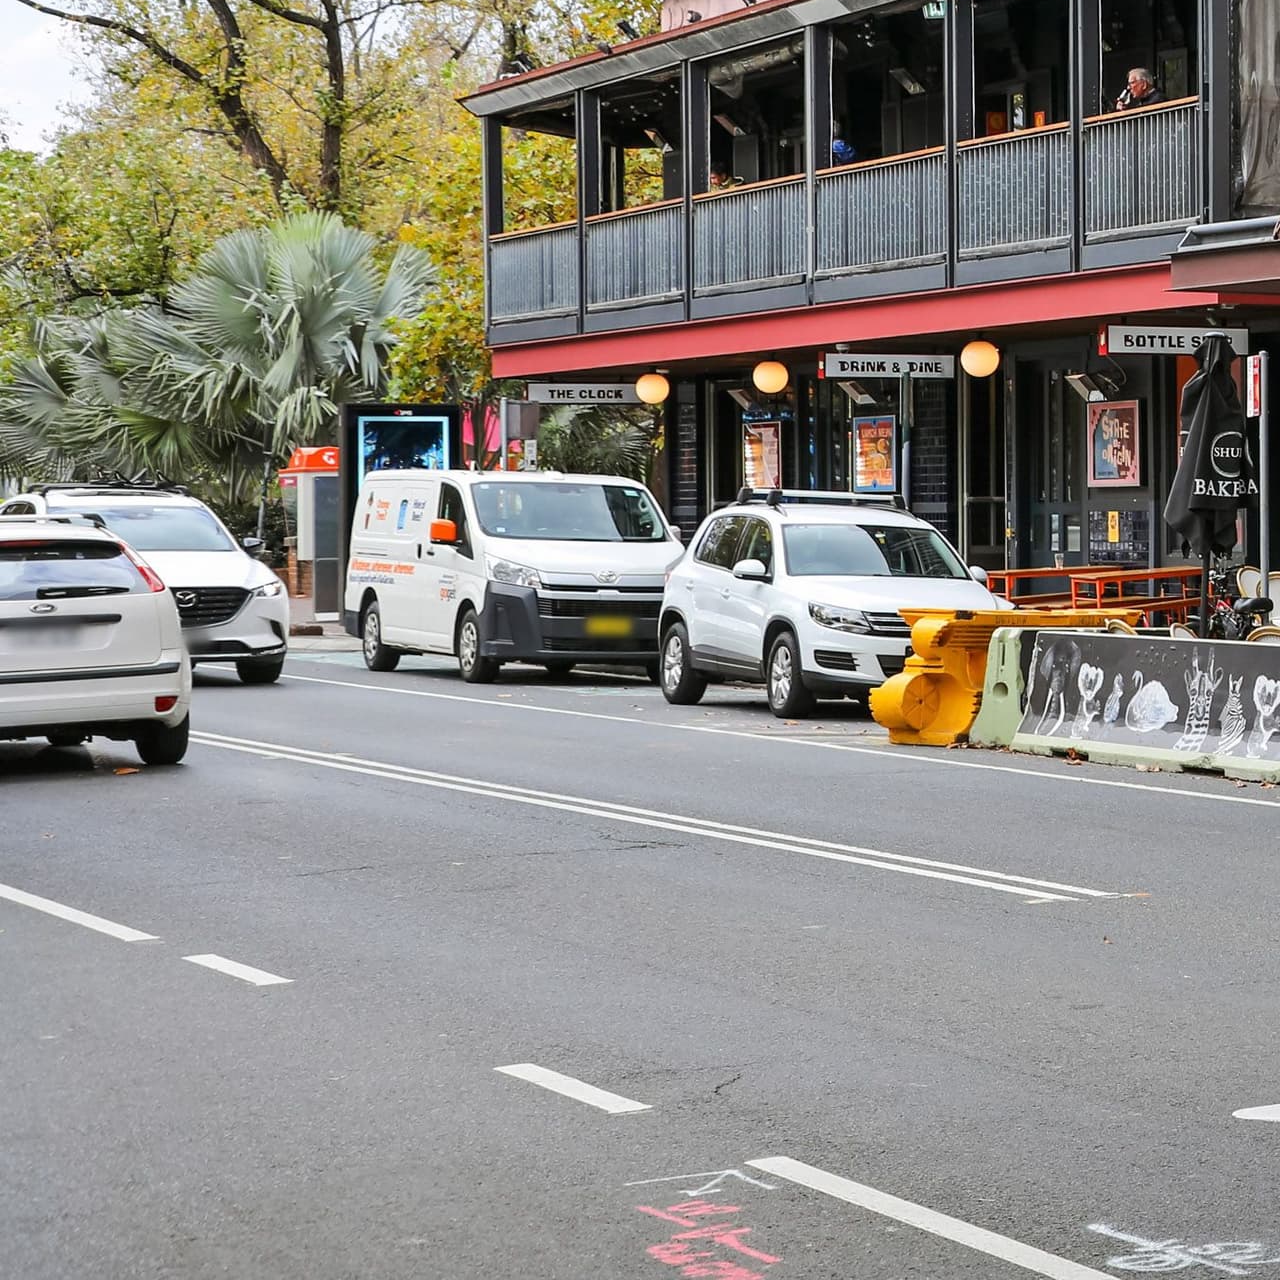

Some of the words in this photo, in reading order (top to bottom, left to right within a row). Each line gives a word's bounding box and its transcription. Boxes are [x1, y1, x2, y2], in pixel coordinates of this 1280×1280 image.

[1123, 335, 1185, 348] BOTTLE
[892, 362, 901, 373] &
[548, 389, 575, 399] THE
[579, 389, 624, 399] CLOCK
[1213, 447, 1242, 458] SHU
